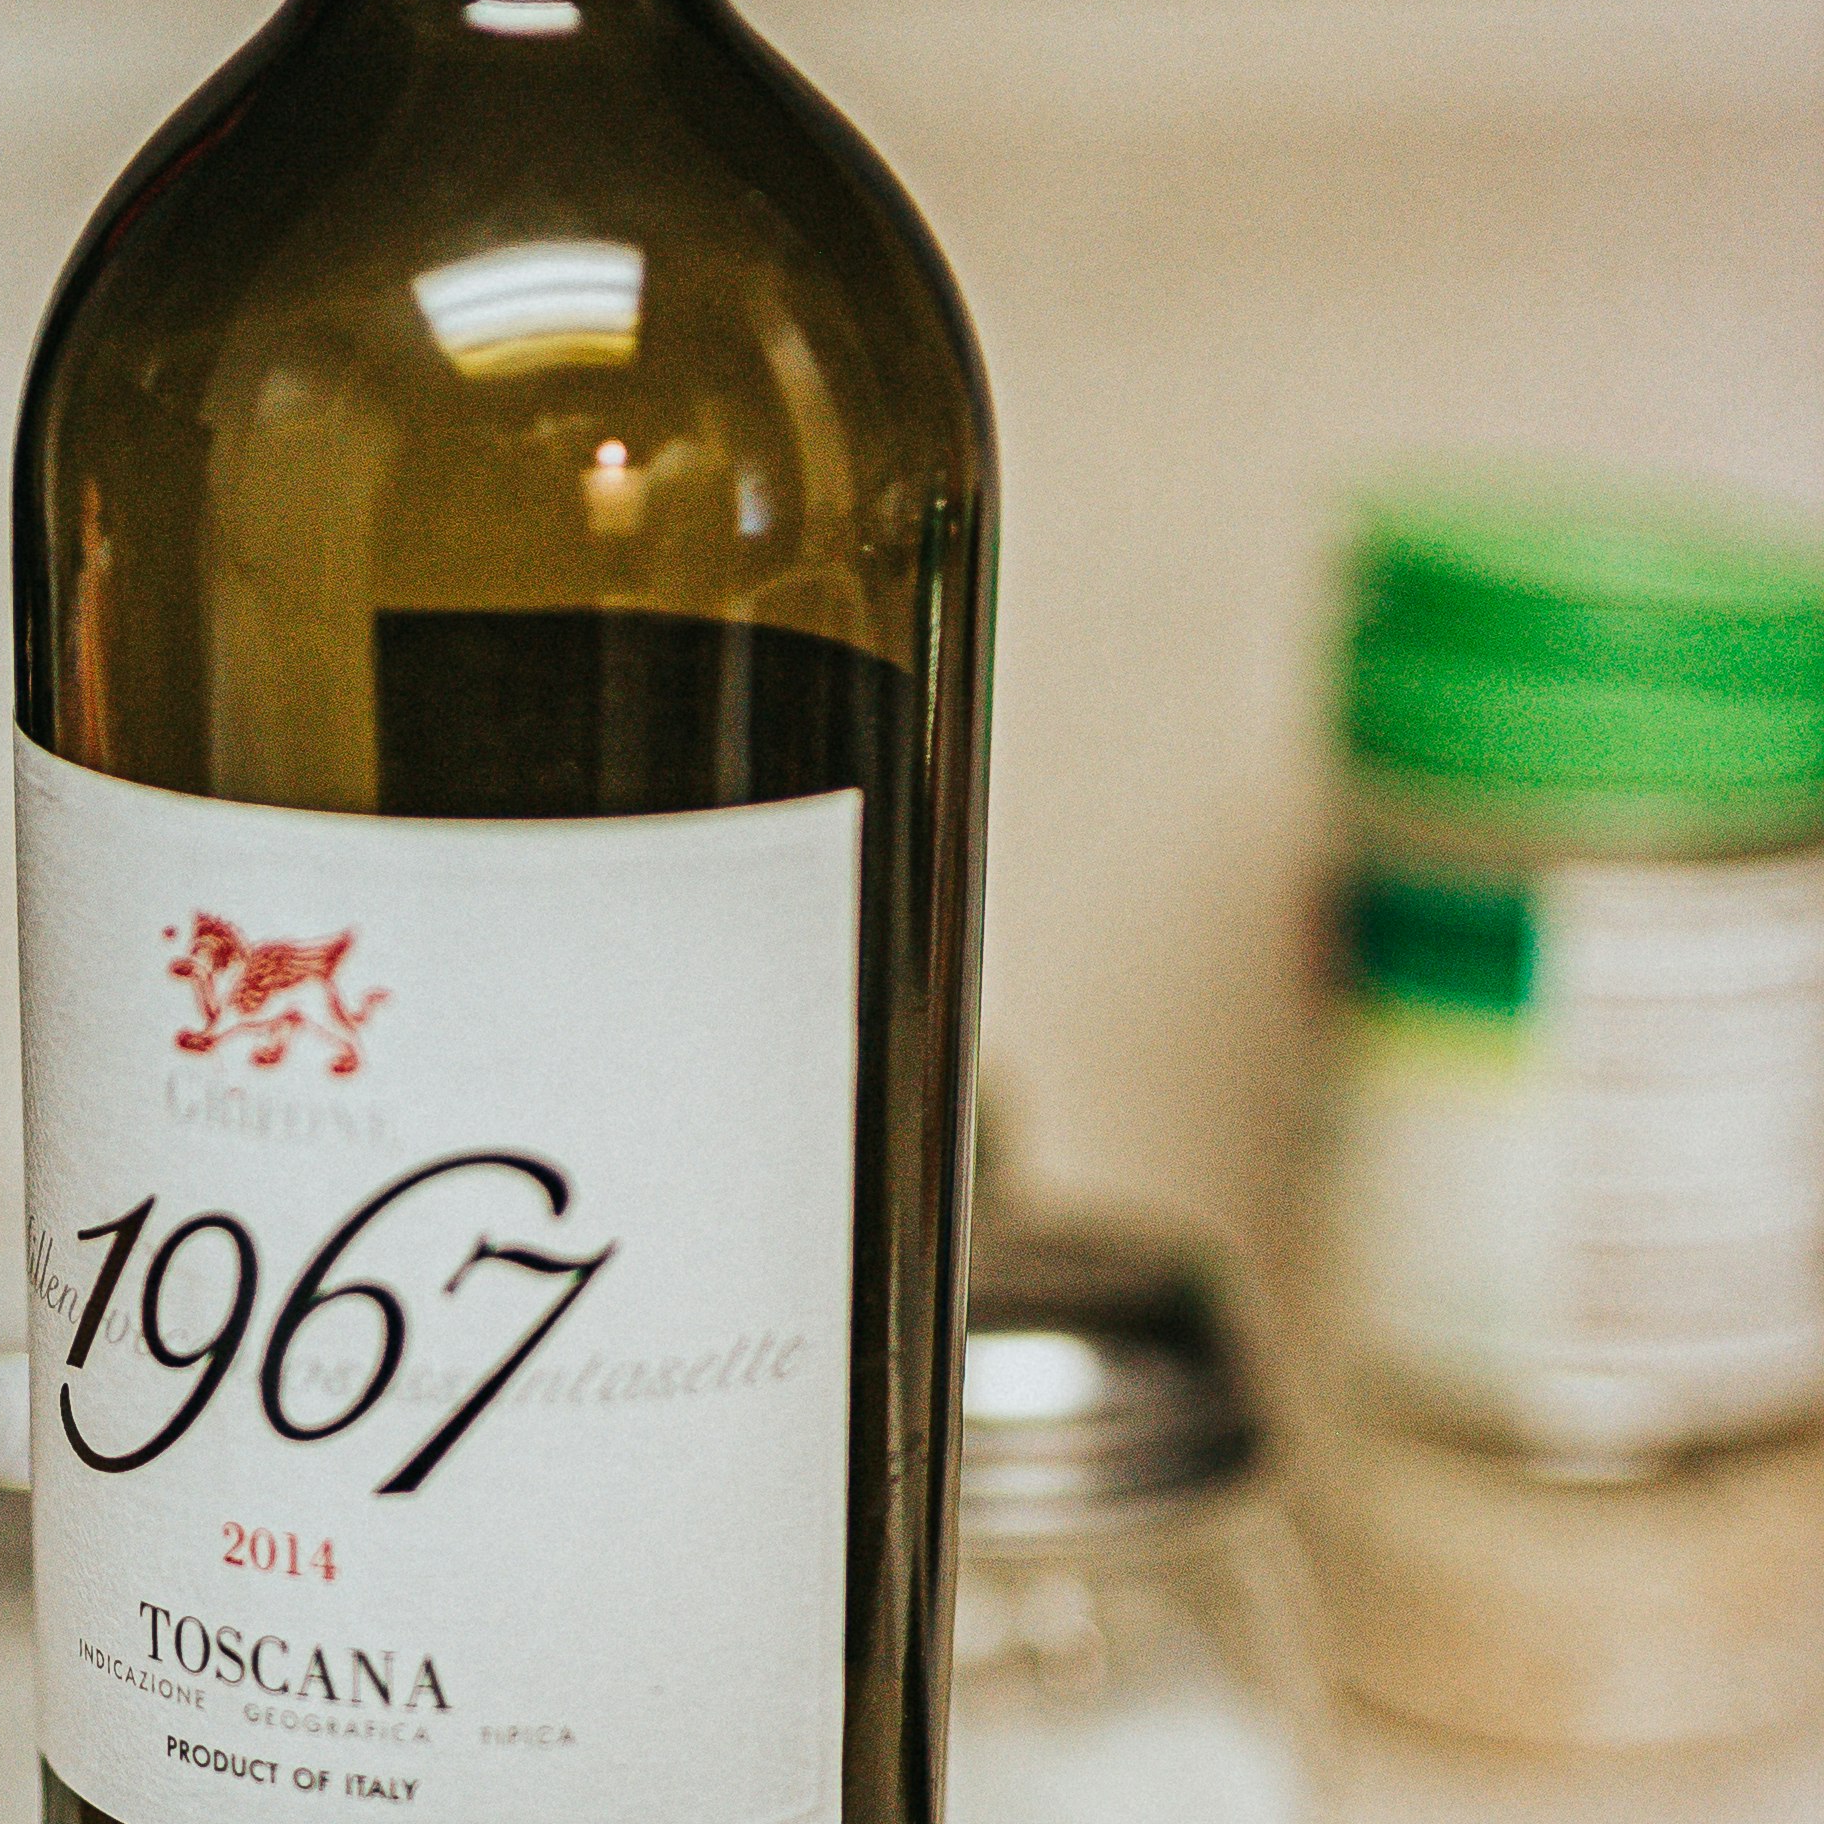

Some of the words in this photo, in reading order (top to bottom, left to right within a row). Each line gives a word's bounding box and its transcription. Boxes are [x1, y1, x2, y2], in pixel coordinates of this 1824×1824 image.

[59, 1149, 621, 1495] 1967
[222, 1520, 338, 1581] 2014
[78, 1637, 206, 1710] INDICAZIONE
[243, 1702, 433, 1745] GEOGRAFICA
[139, 1600, 453, 1711] TOSCANA
[166, 1734, 278, 1784] PRODUCT
[293, 1767, 331, 1792] OF
[344, 1773, 419, 1804] ITALY
